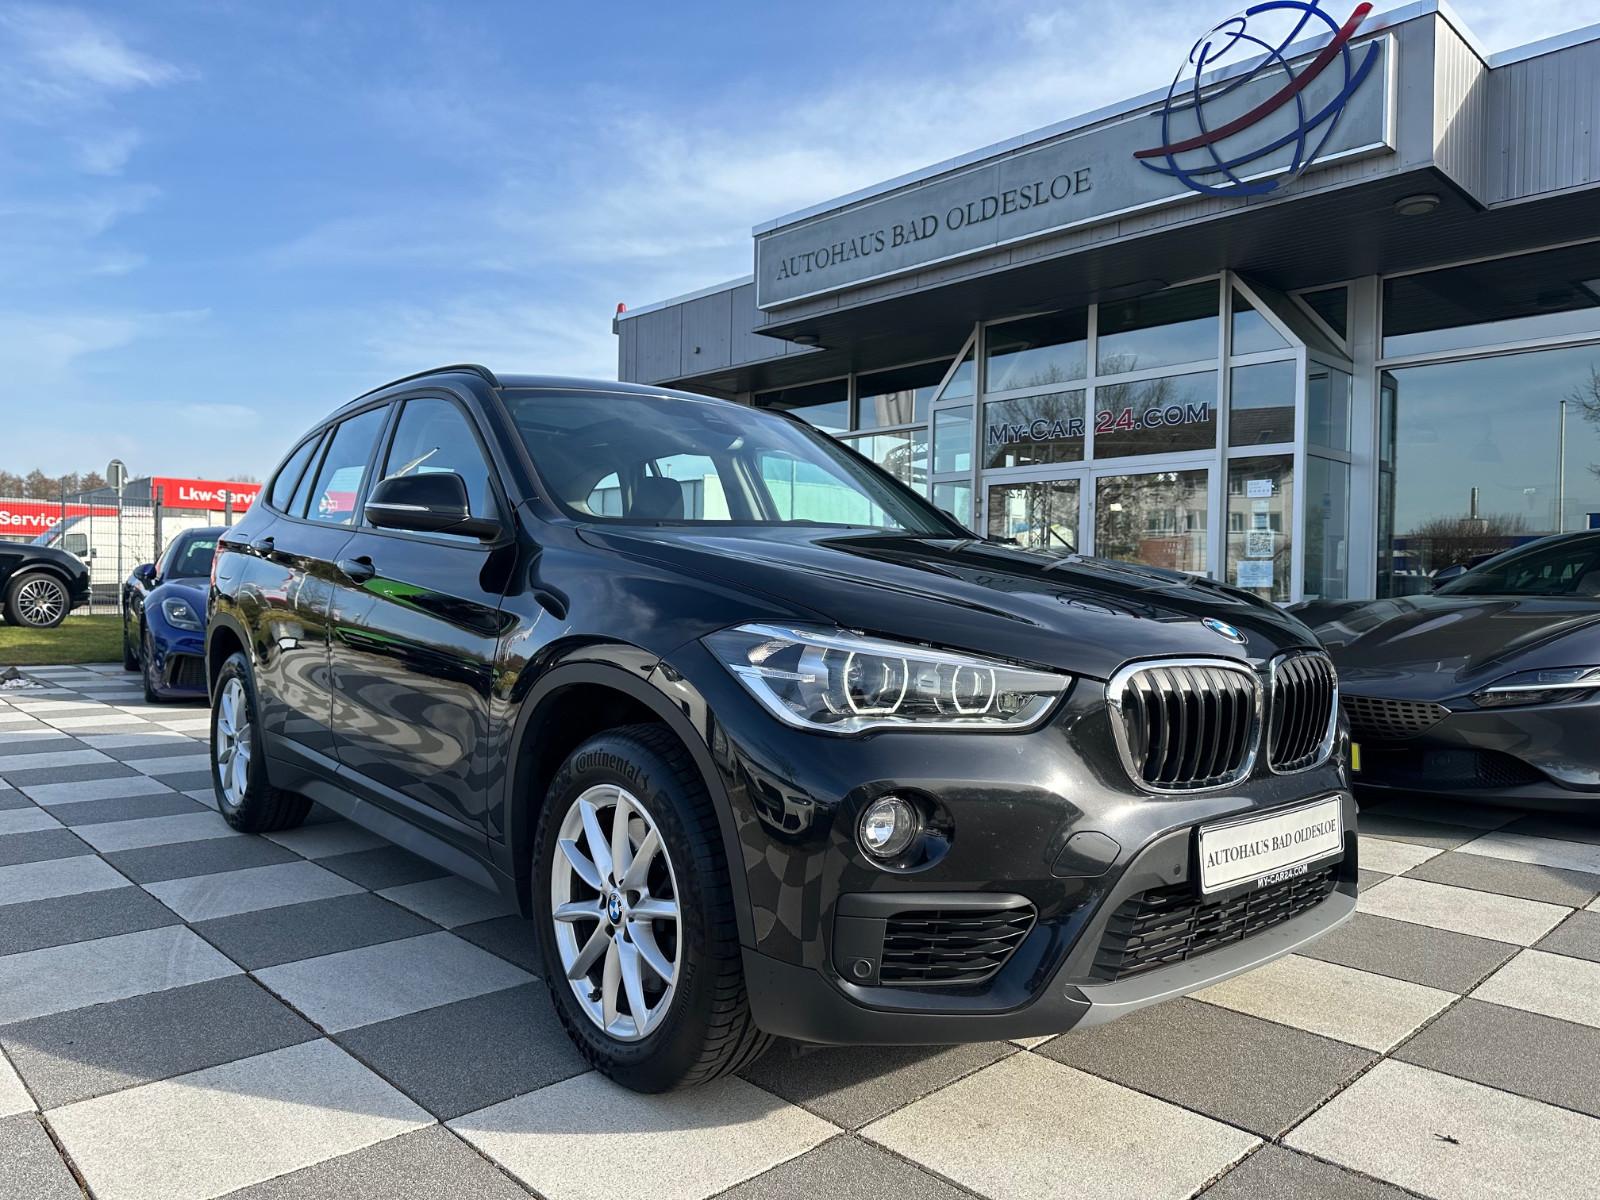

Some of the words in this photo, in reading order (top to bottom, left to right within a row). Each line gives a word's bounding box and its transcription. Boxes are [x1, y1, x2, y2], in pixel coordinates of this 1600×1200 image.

[777, 230, 885, 280] AUTOHAUS
[891, 215, 939, 248] BAD
[946, 167, 1092, 230] OLDESLOE
[576, 748, 642, 784] Continental
[1207, 838, 1269, 868] AUTOHAUS
[1271, 832, 1292, 851] BAD
[1294, 818, 1336, 844] OLDESLOE
[1257, 863, 1308, 888] MY-CAR24.COM
